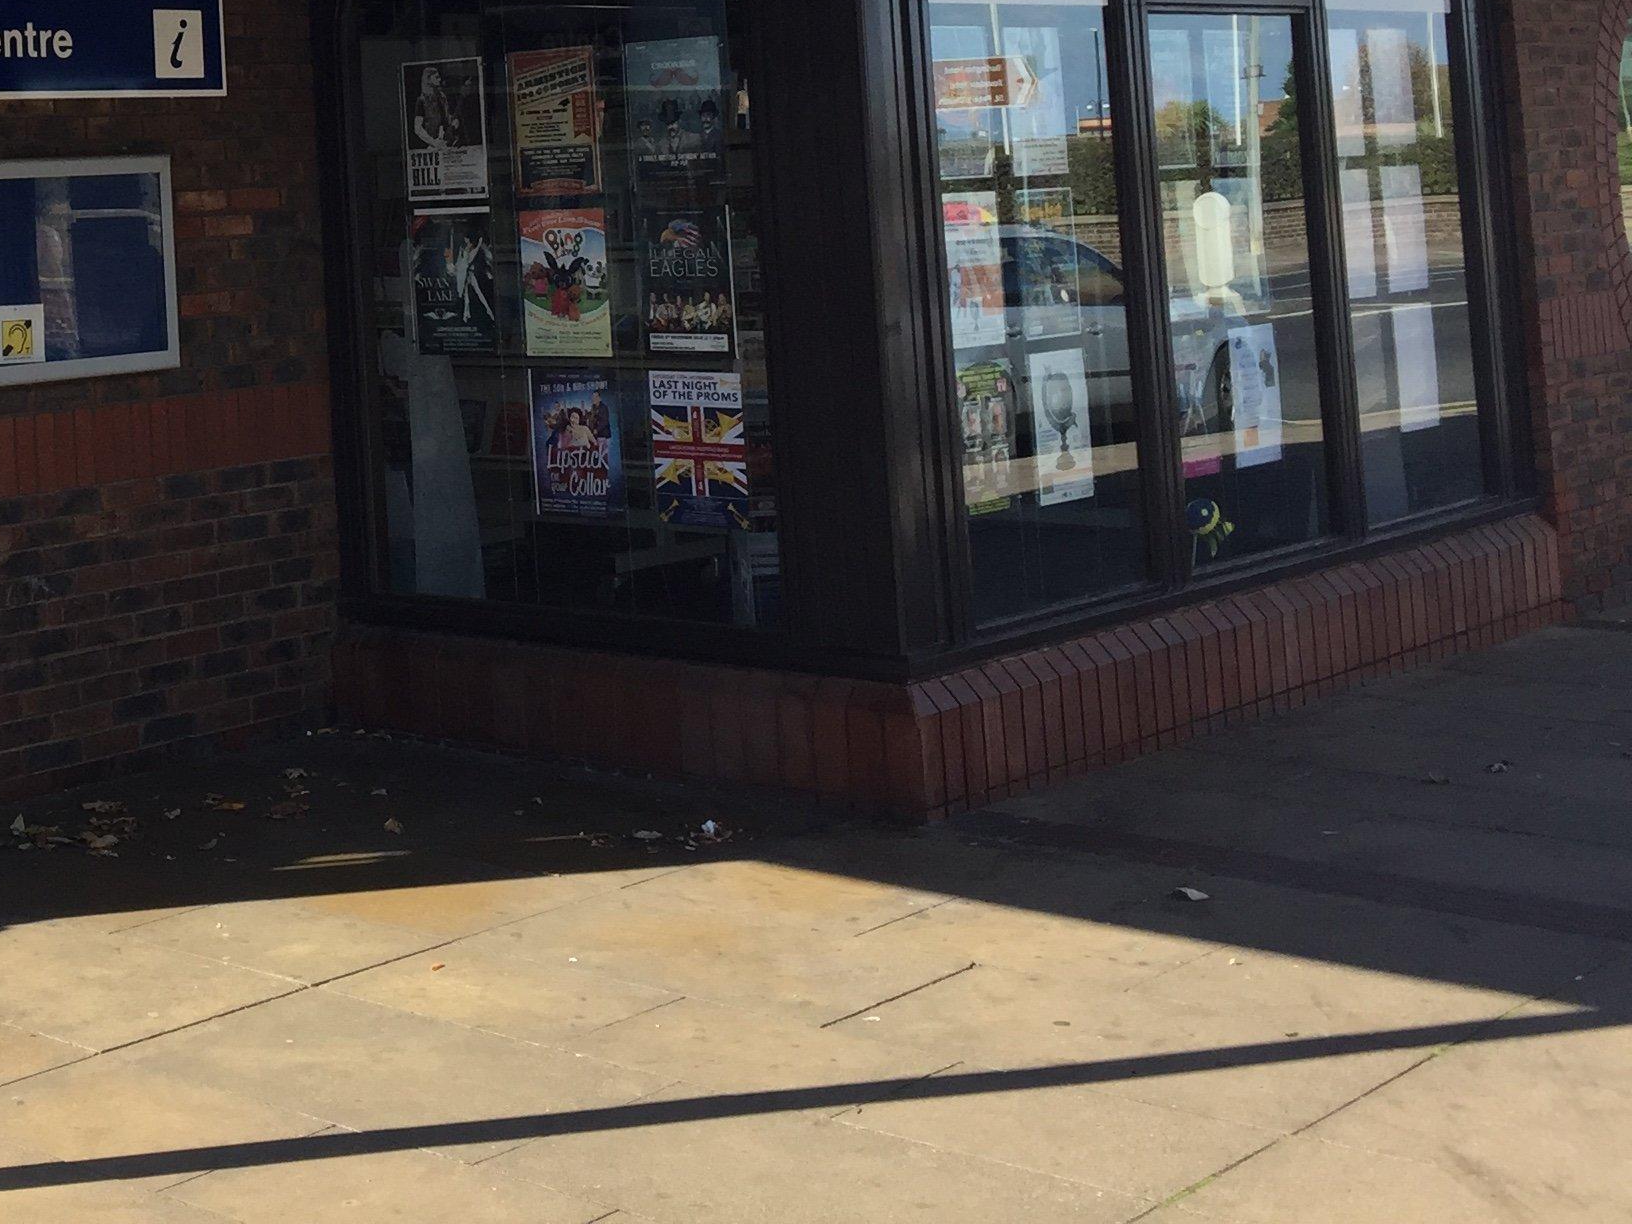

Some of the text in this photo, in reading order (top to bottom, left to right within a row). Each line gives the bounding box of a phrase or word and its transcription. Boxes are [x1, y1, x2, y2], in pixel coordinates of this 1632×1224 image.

[170, 19, 187, 69] i
[411, 152, 440, 167] STEVE
[412, 167, 441, 186] HILL
[546, 229, 583, 257] Bing
[650, 259, 719, 277] EAGLES
[427, 289, 454, 303] LAKE
[652, 380, 718, 391] LAST NIGHT
[653, 390, 738, 402] OF THE PROMS
[547, 446, 610, 475] Lipstick
[570, 471, 610, 497] Collar
